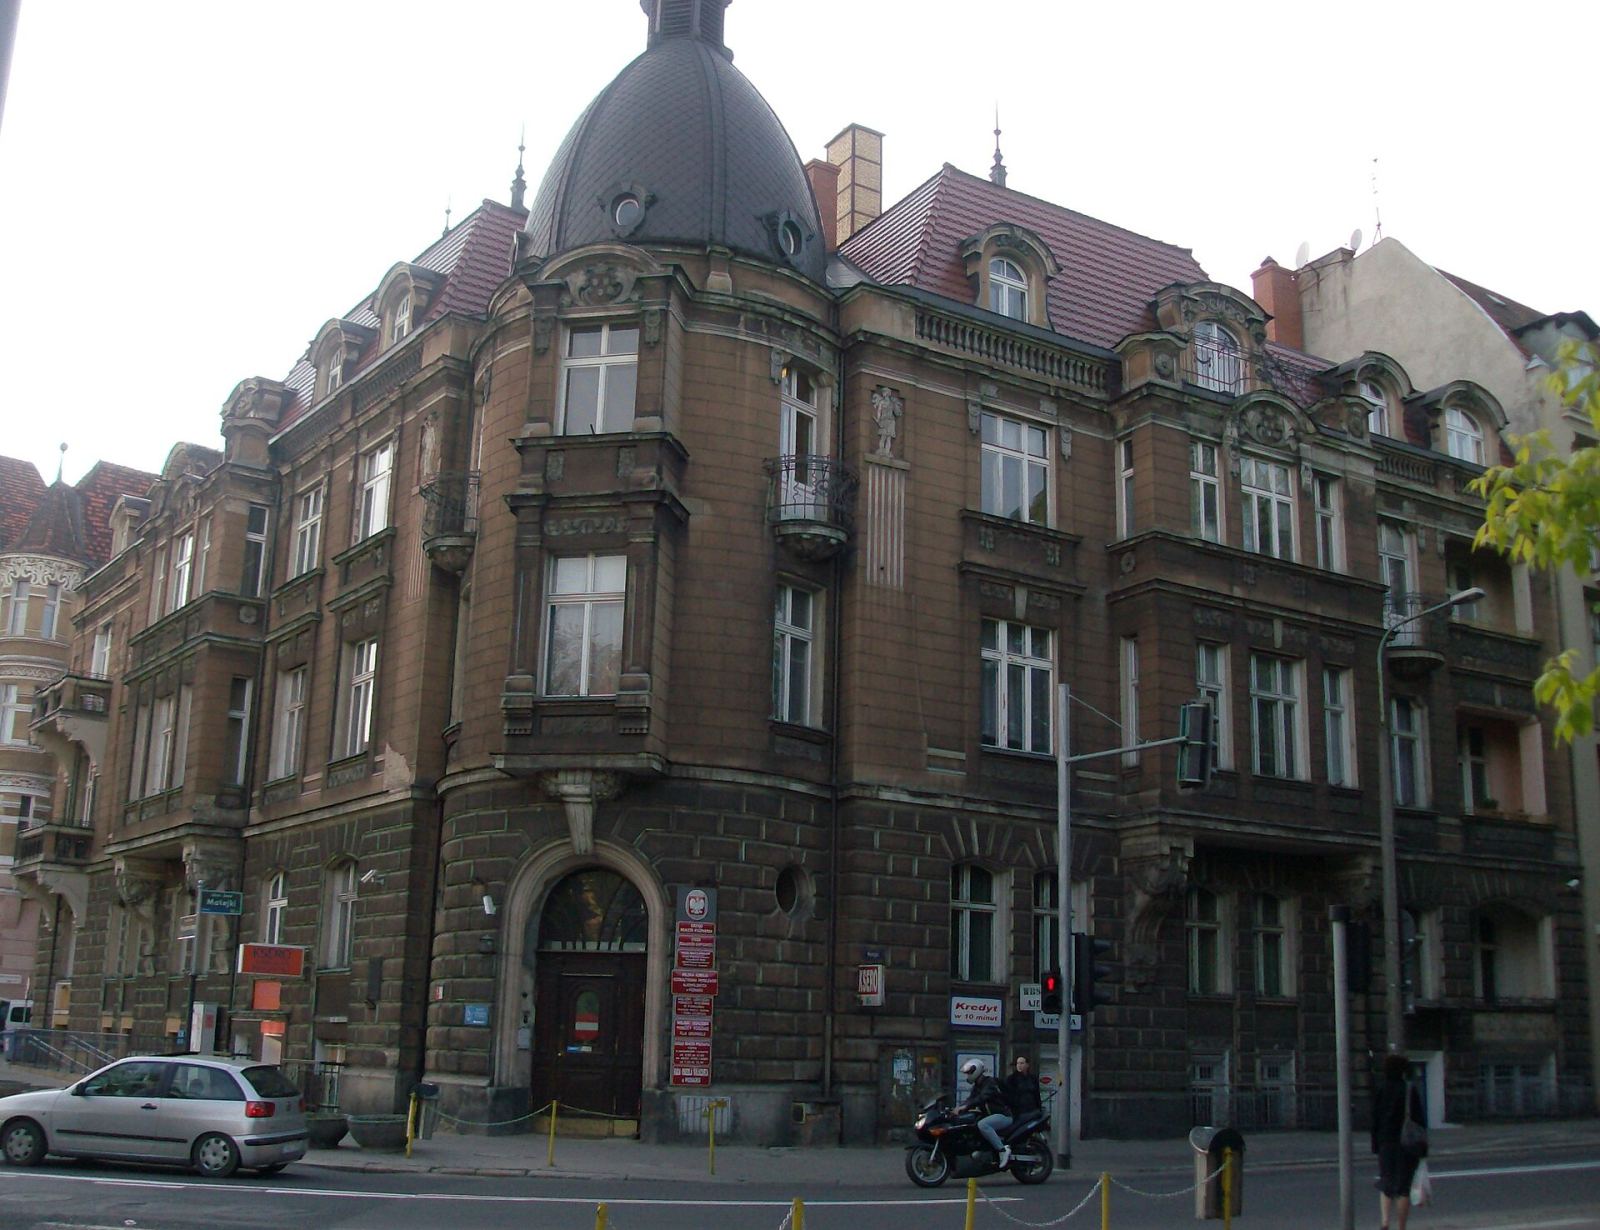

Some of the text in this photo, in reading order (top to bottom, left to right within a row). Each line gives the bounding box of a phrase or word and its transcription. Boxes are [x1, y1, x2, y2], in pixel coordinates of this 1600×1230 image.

[207, 898, 237, 908] Matejki
[858, 968, 878, 993] KSERO
[955, 1002, 998, 1013] Kredyt
[964, 1013, 974, 1021] 10
